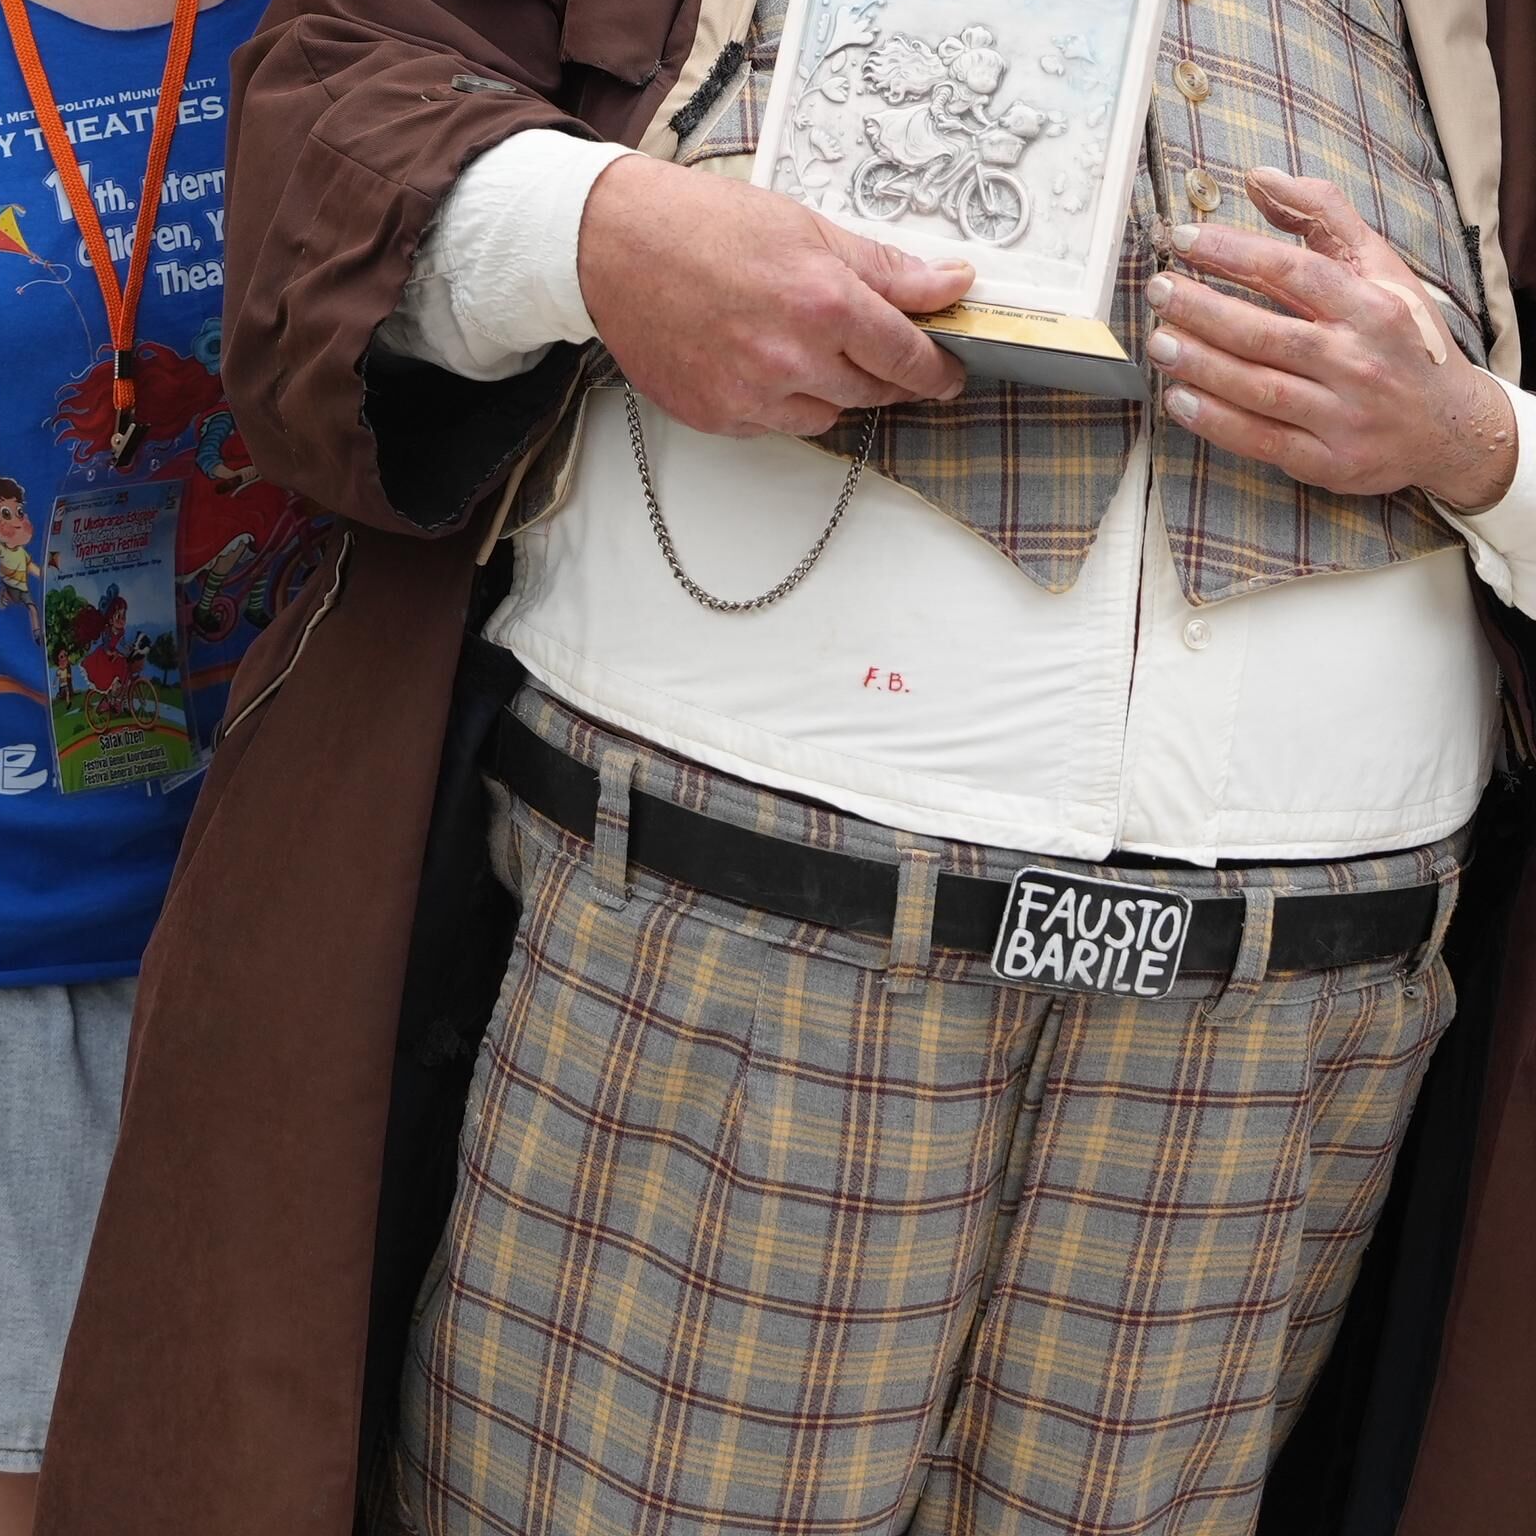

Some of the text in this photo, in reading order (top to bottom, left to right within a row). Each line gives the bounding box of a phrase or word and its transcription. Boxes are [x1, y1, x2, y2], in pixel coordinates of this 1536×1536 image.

[6, 95, 115, 125] METPOLITAN
[119, 77, 217, 103] MUNICALITY
[43, 160, 137, 224] 1th.
[155, 260, 225, 297] Thea
[1016, 880, 1182, 953] FAUSTO
[1002, 927, 1168, 996] BARILE
